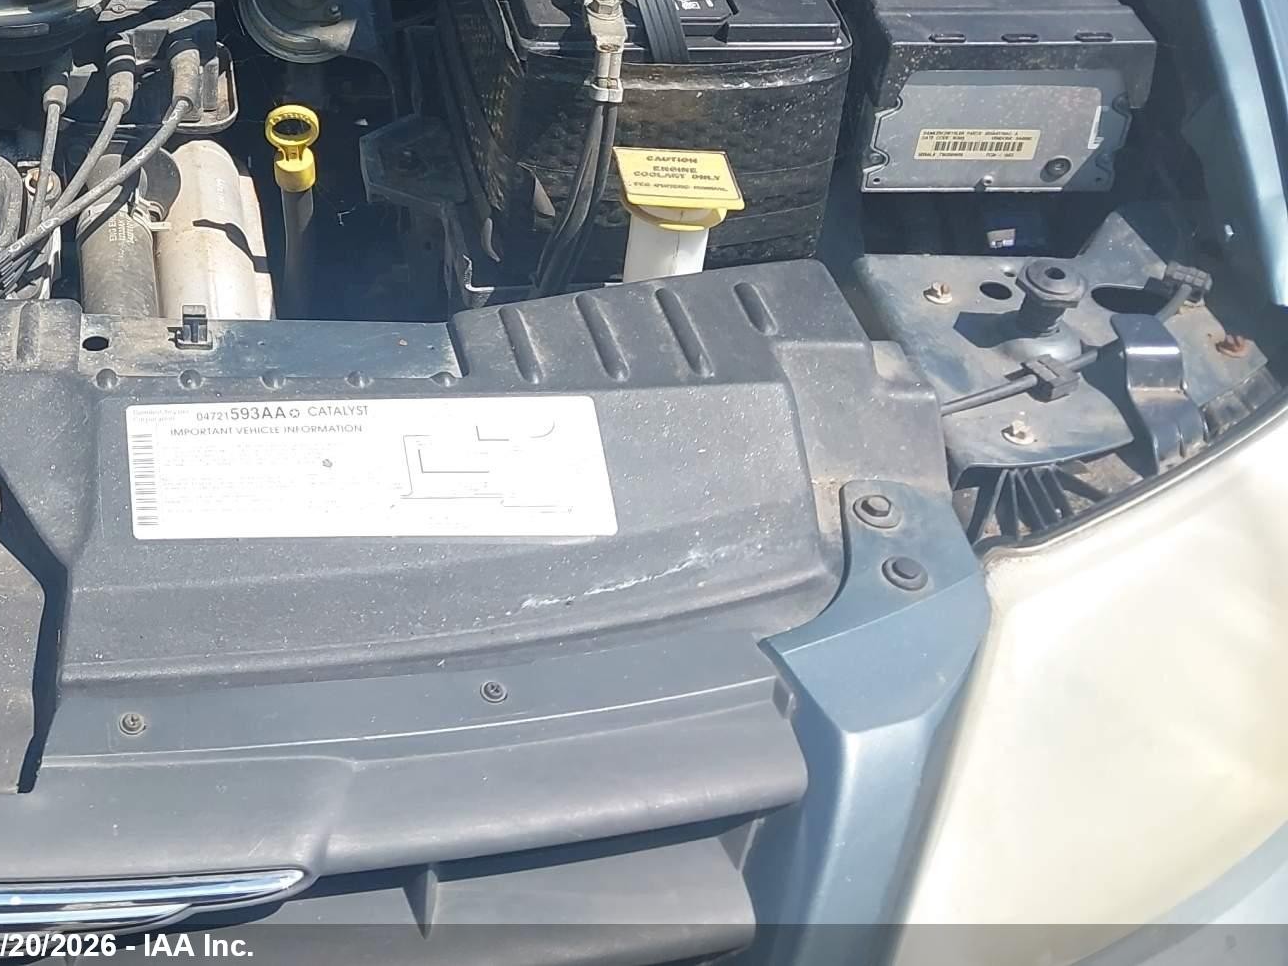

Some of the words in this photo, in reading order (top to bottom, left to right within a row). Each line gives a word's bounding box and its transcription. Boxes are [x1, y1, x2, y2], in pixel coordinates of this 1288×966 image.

[646, 155, 698, 163] CAUTION
[633, 171, 686, 179] COOLANT
[307, 406, 368, 416] CATALYST
[169, 425, 234, 436] IMPORTANT
[235, 425, 281, 435] VEHICLE
[284, 424, 362, 433] INFORMATION
